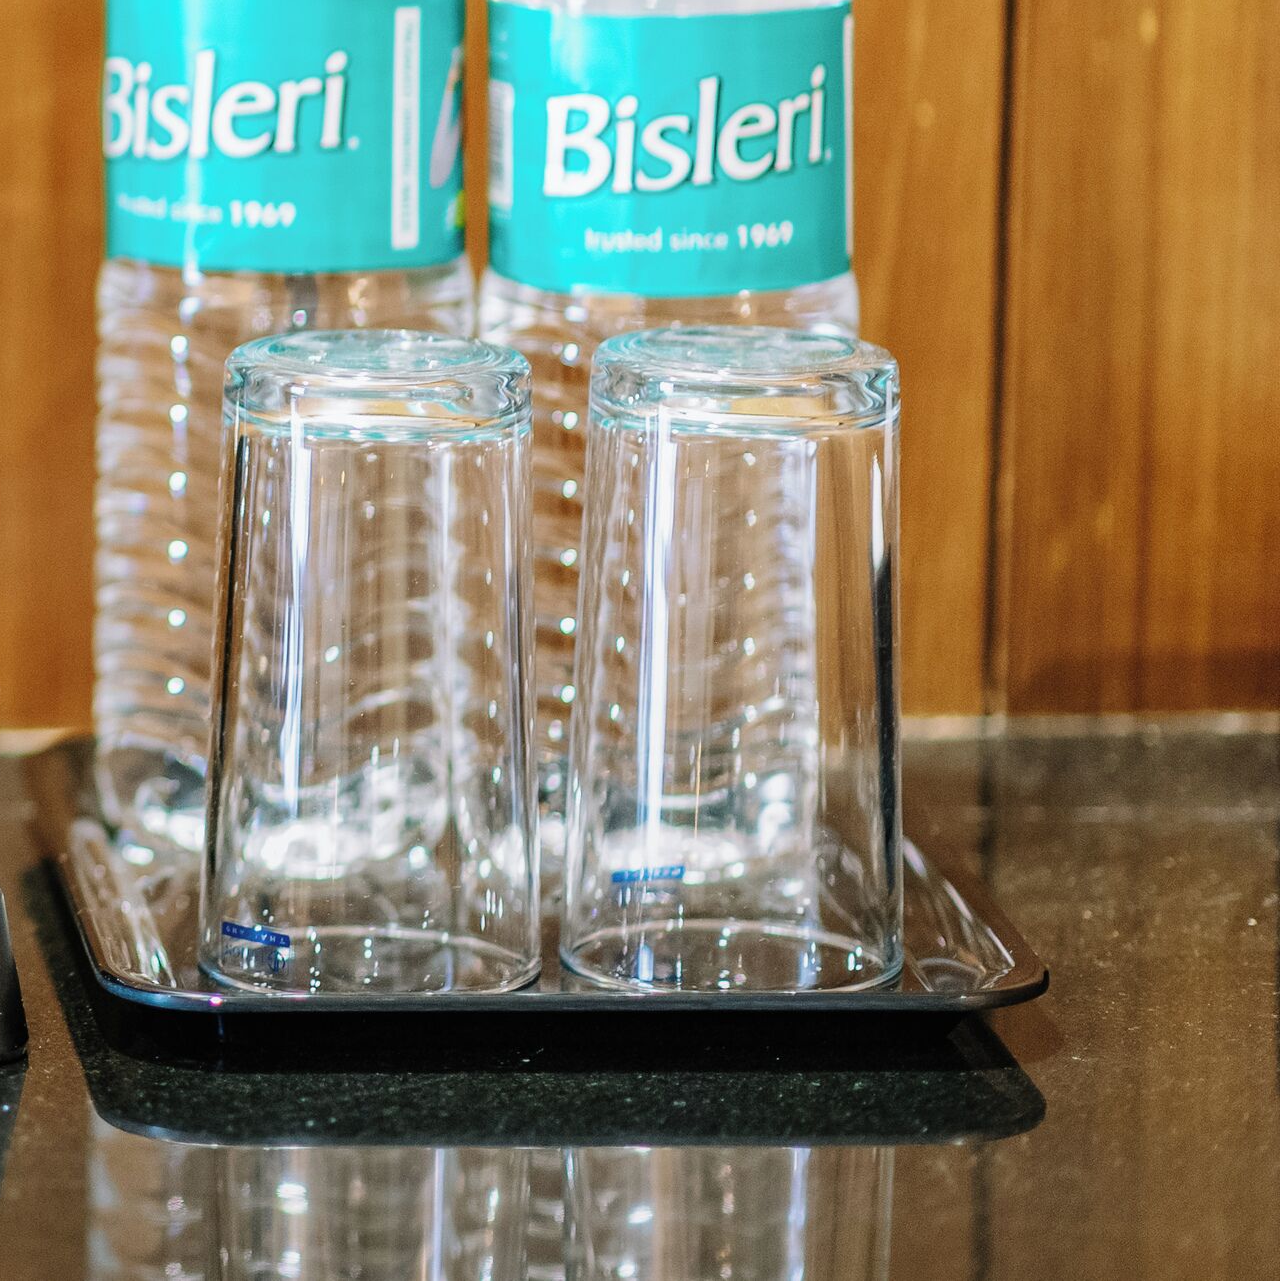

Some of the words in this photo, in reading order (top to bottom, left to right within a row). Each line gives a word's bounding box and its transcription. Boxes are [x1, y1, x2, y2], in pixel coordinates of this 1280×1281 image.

[543, 63, 826, 197] Bisleri
[229, 199, 297, 228] 1969
[584, 226, 663, 253] trusted
[669, 227, 729, 252] since
[737, 220, 794, 249] 1969
